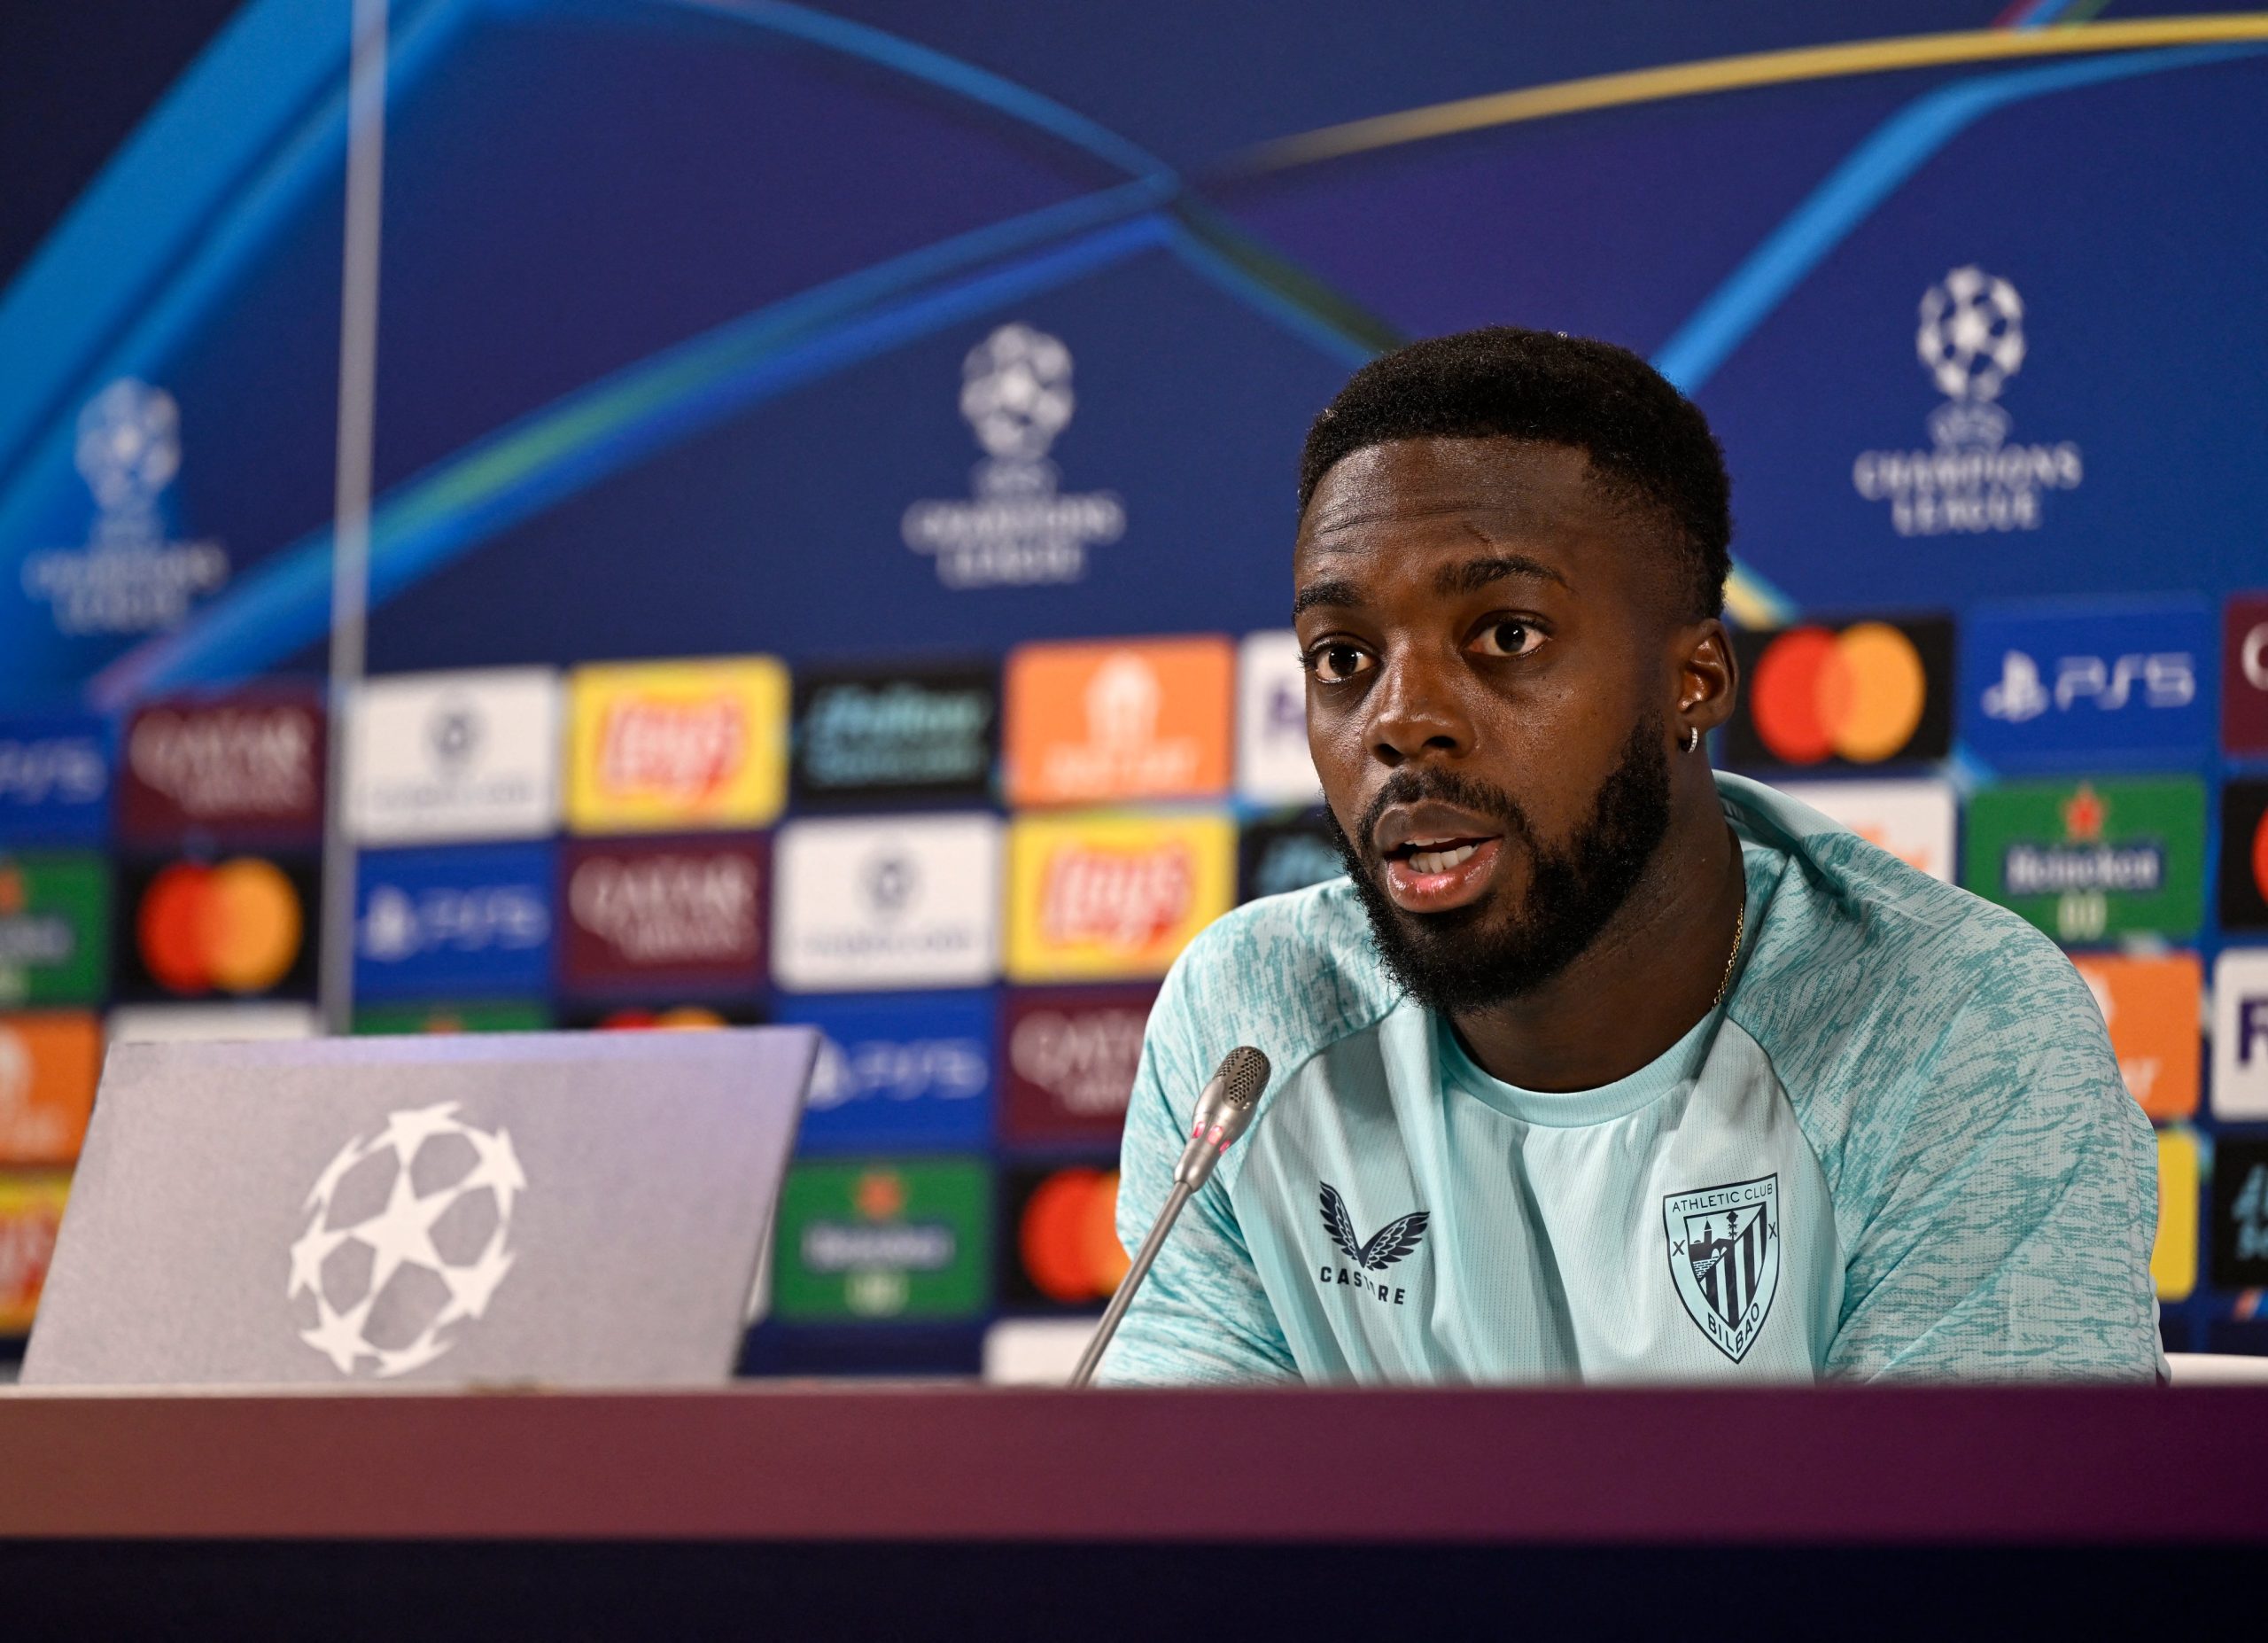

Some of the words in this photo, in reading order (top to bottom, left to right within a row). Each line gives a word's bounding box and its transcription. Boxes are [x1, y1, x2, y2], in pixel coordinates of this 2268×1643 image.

[1853, 443, 2083, 500] CHAMPIONS
[1892, 487, 2042, 535] LEAGUE
[2055, 652, 2195, 711] PS5
[2006, 844, 2159, 891] Heineken
[1673, 1191, 1740, 1212] ATHLETIC
[1744, 1183, 1773, 1200] CLUB
[1320, 1265, 1405, 1304] CASRE
[1707, 1303, 1759, 1354] BILBAO
